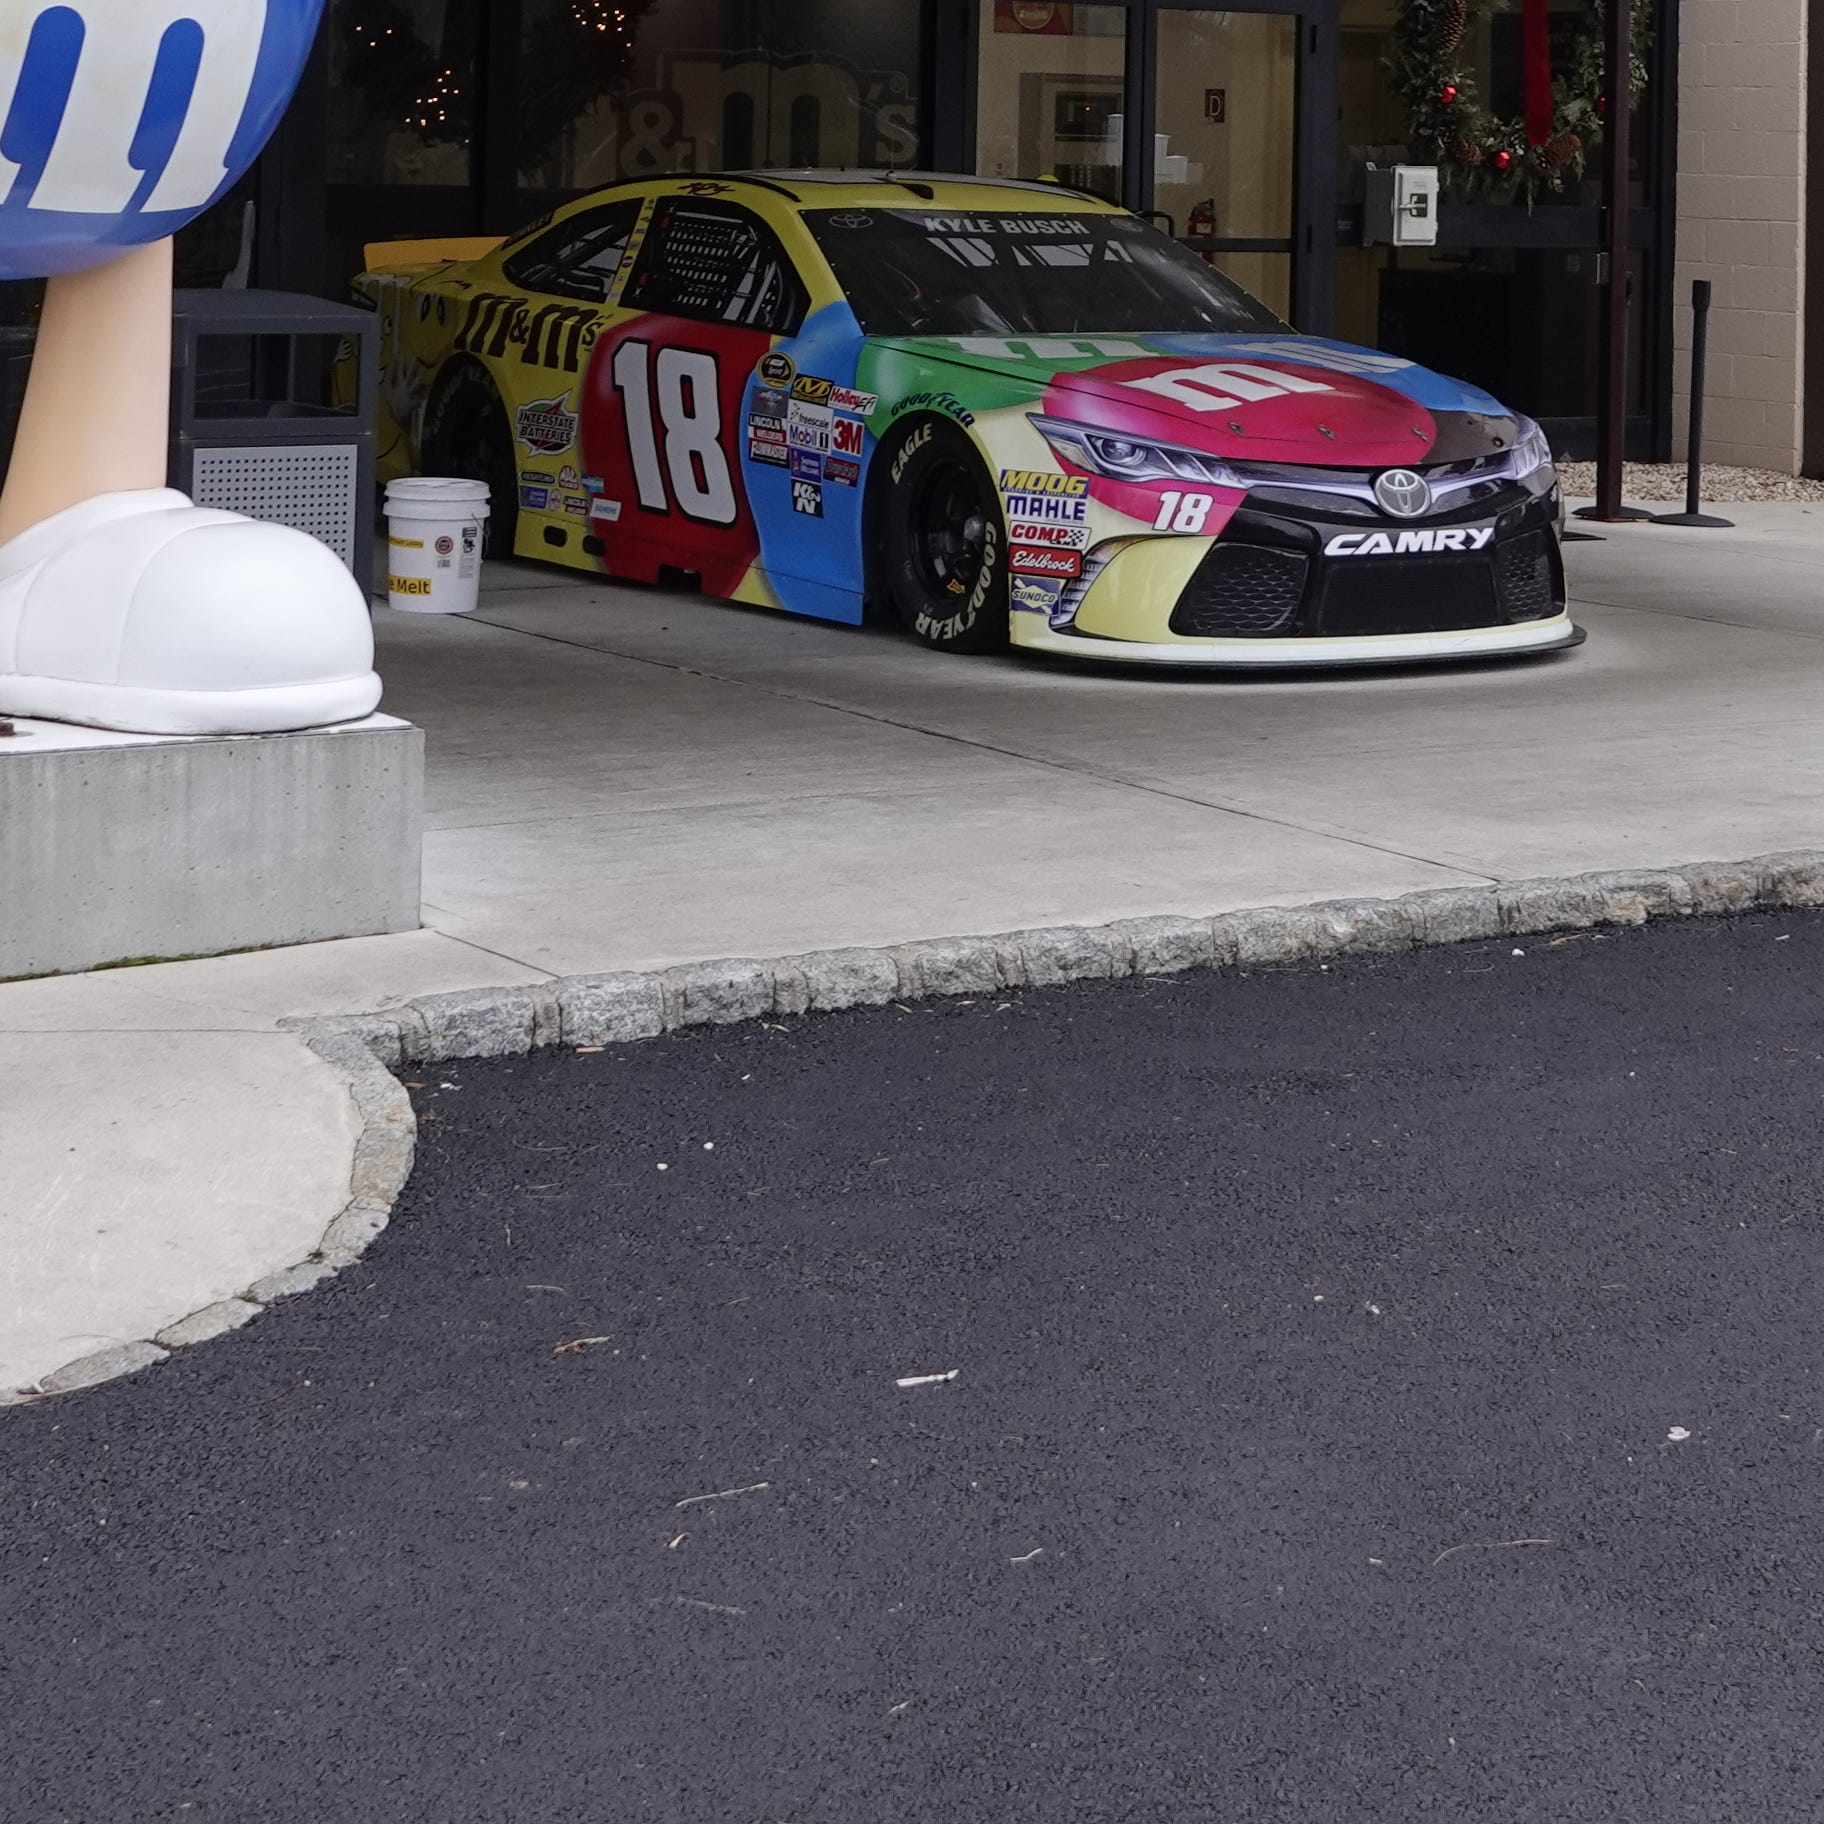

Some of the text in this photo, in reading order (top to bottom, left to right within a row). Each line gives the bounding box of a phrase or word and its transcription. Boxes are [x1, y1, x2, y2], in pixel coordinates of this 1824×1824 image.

[925, 217, 1091, 235] KYLE BUSCH
[518, 410, 576, 429] INTERSTATE
[890, 392, 976, 429] GOODYEAR
[519, 425, 573, 443] BATTERIES
[612, 340, 737, 527] 18
[789, 424, 818, 446] Mobil
[833, 419, 863, 455] 3M
[890, 422, 933, 485] EAGLE
[1000, 470, 1089, 495] MOOG
[1006, 495, 1086, 521] MAHLE
[1151, 490, 1213, 534] 18
[1011, 524, 1068, 542] COMP
[1323, 527, 1497, 557] CAMRY
[1012, 550, 1075, 572] Edelbrock
[397, 578, 430, 594] Melt
[1012, 590, 1056, 603] SUNOCO
